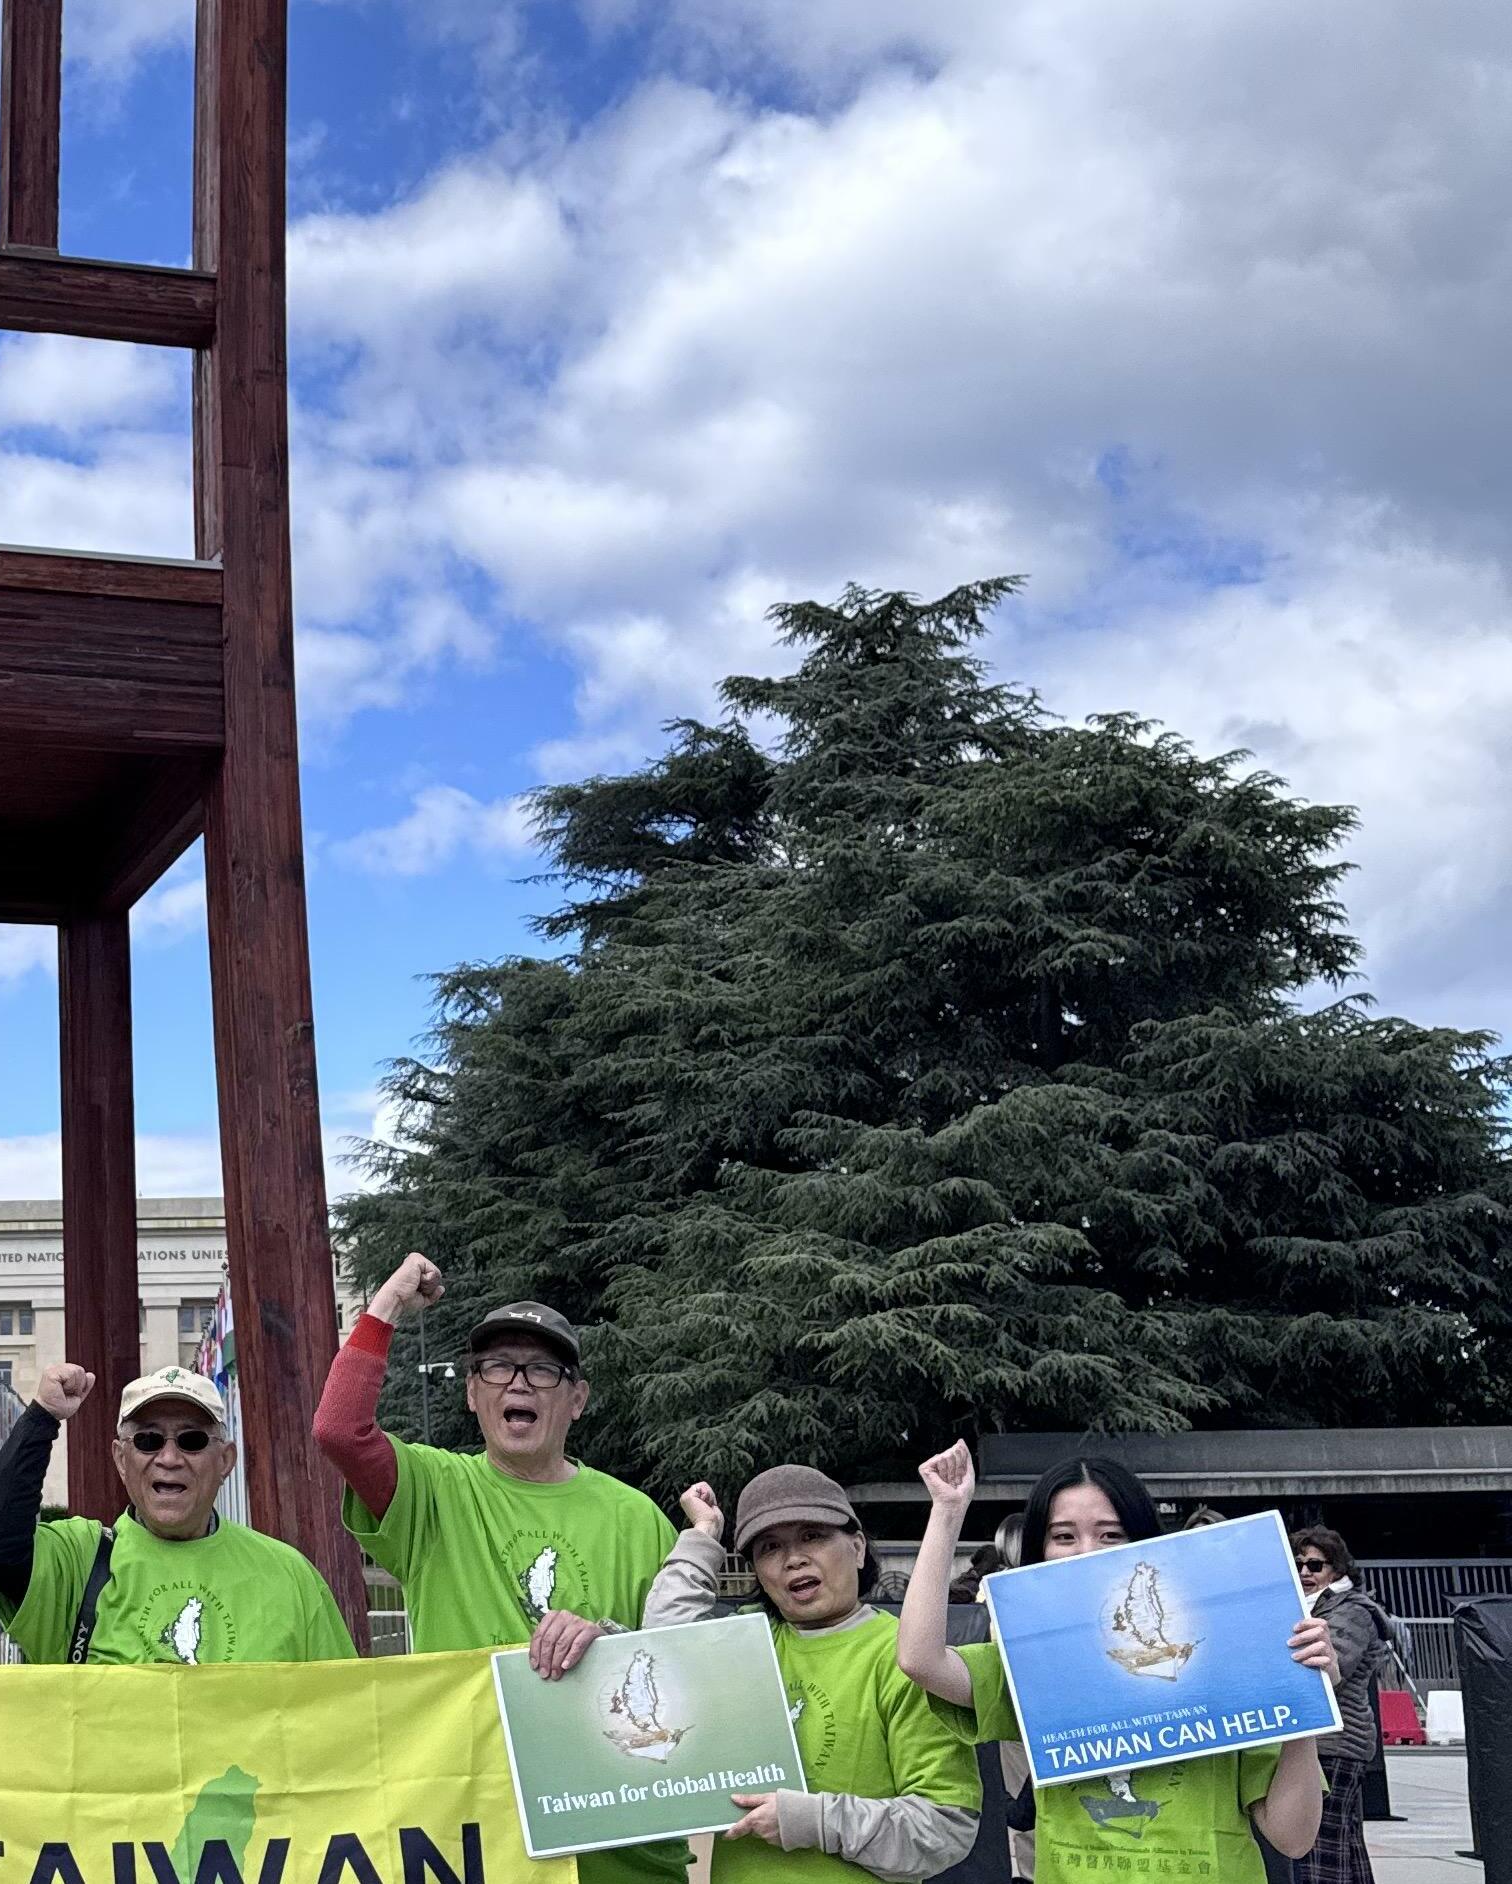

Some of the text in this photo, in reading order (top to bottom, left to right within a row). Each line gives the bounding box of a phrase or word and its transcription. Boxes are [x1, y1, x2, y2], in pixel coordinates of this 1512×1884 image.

[28, 1252, 64, 1263] NATIO
[138, 1250, 186, 1261] ATIONS
[528, 1530, 548, 1539] ALL
[149, 1584, 168, 1603] FOR
[172, 1581, 193, 1590] ALL
[199, 1583, 224, 1611] WITH
[72, 1620, 89, 1663] ONY
[808, 1682, 830, 1709] WITH
[815, 1712, 836, 1770] TAIWAN
[1041, 1704, 1208, 1744] HEALTH FOR ALL WITH TAIWAN
[1045, 1704, 1298, 1769] TAIWAN CAN HELP.
[538, 1763, 786, 1815] Taiwan for Global Health
